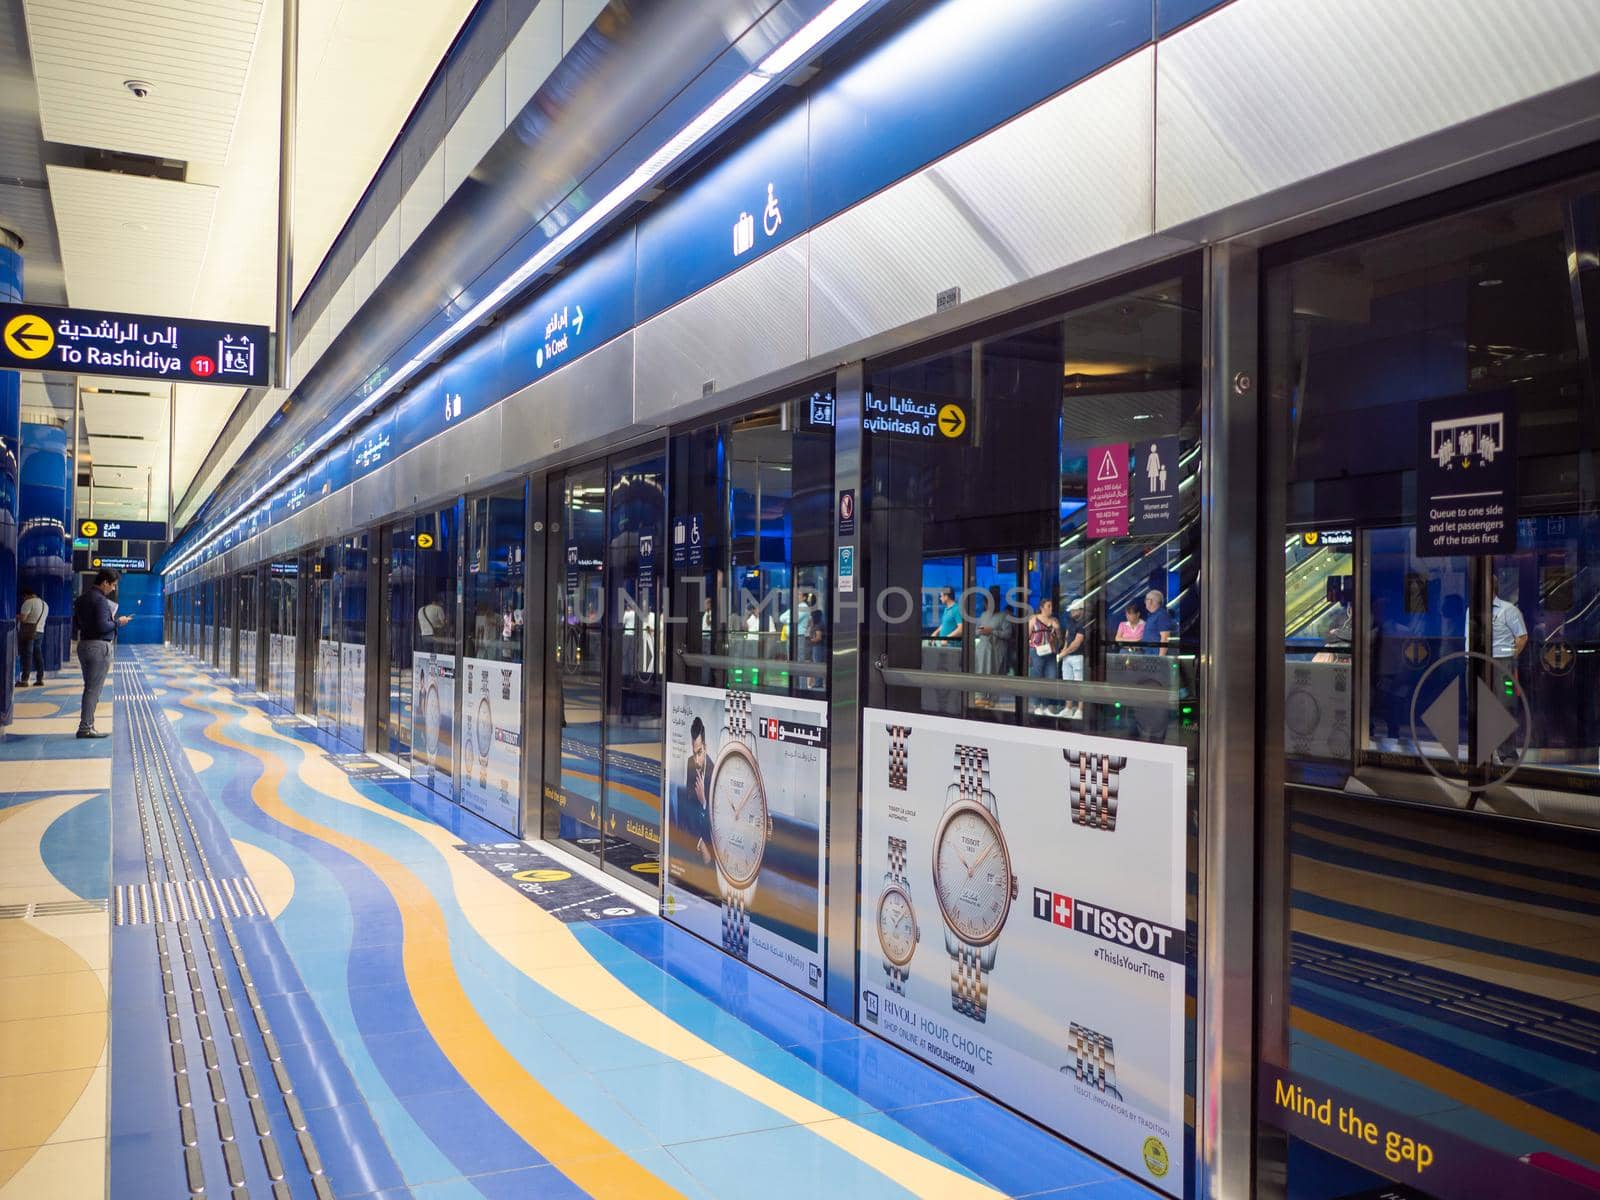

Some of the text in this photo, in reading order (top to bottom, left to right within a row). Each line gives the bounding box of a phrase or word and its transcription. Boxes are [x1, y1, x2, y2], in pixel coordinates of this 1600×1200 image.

[58, 319, 178, 348] إلى الراشدية
[552, 333, 568, 356] Creek
[57, 344, 182, 374] To Rashidiya
[196, 360, 210, 373] 11
[1429, 505, 1504, 520] Queue to one side
[1429, 519, 1504, 534] and let passengers
[1433, 533, 1499, 546] off the train first
[779, 725, 822, 746] تيسو
[1076, 903, 1173, 956] TISSOT
[1094, 947, 1166, 982] #ThisIsYourTime
[883, 999, 993, 1067] RIVOLI HOUR CHOICE
[899, 1027, 919, 1046] ONLINE
[920, 1039, 926, 1049] AT
[927, 1042, 976, 1076] RIVOLISHOP.COM
[1275, 1079, 1434, 1173] Mind the gap
